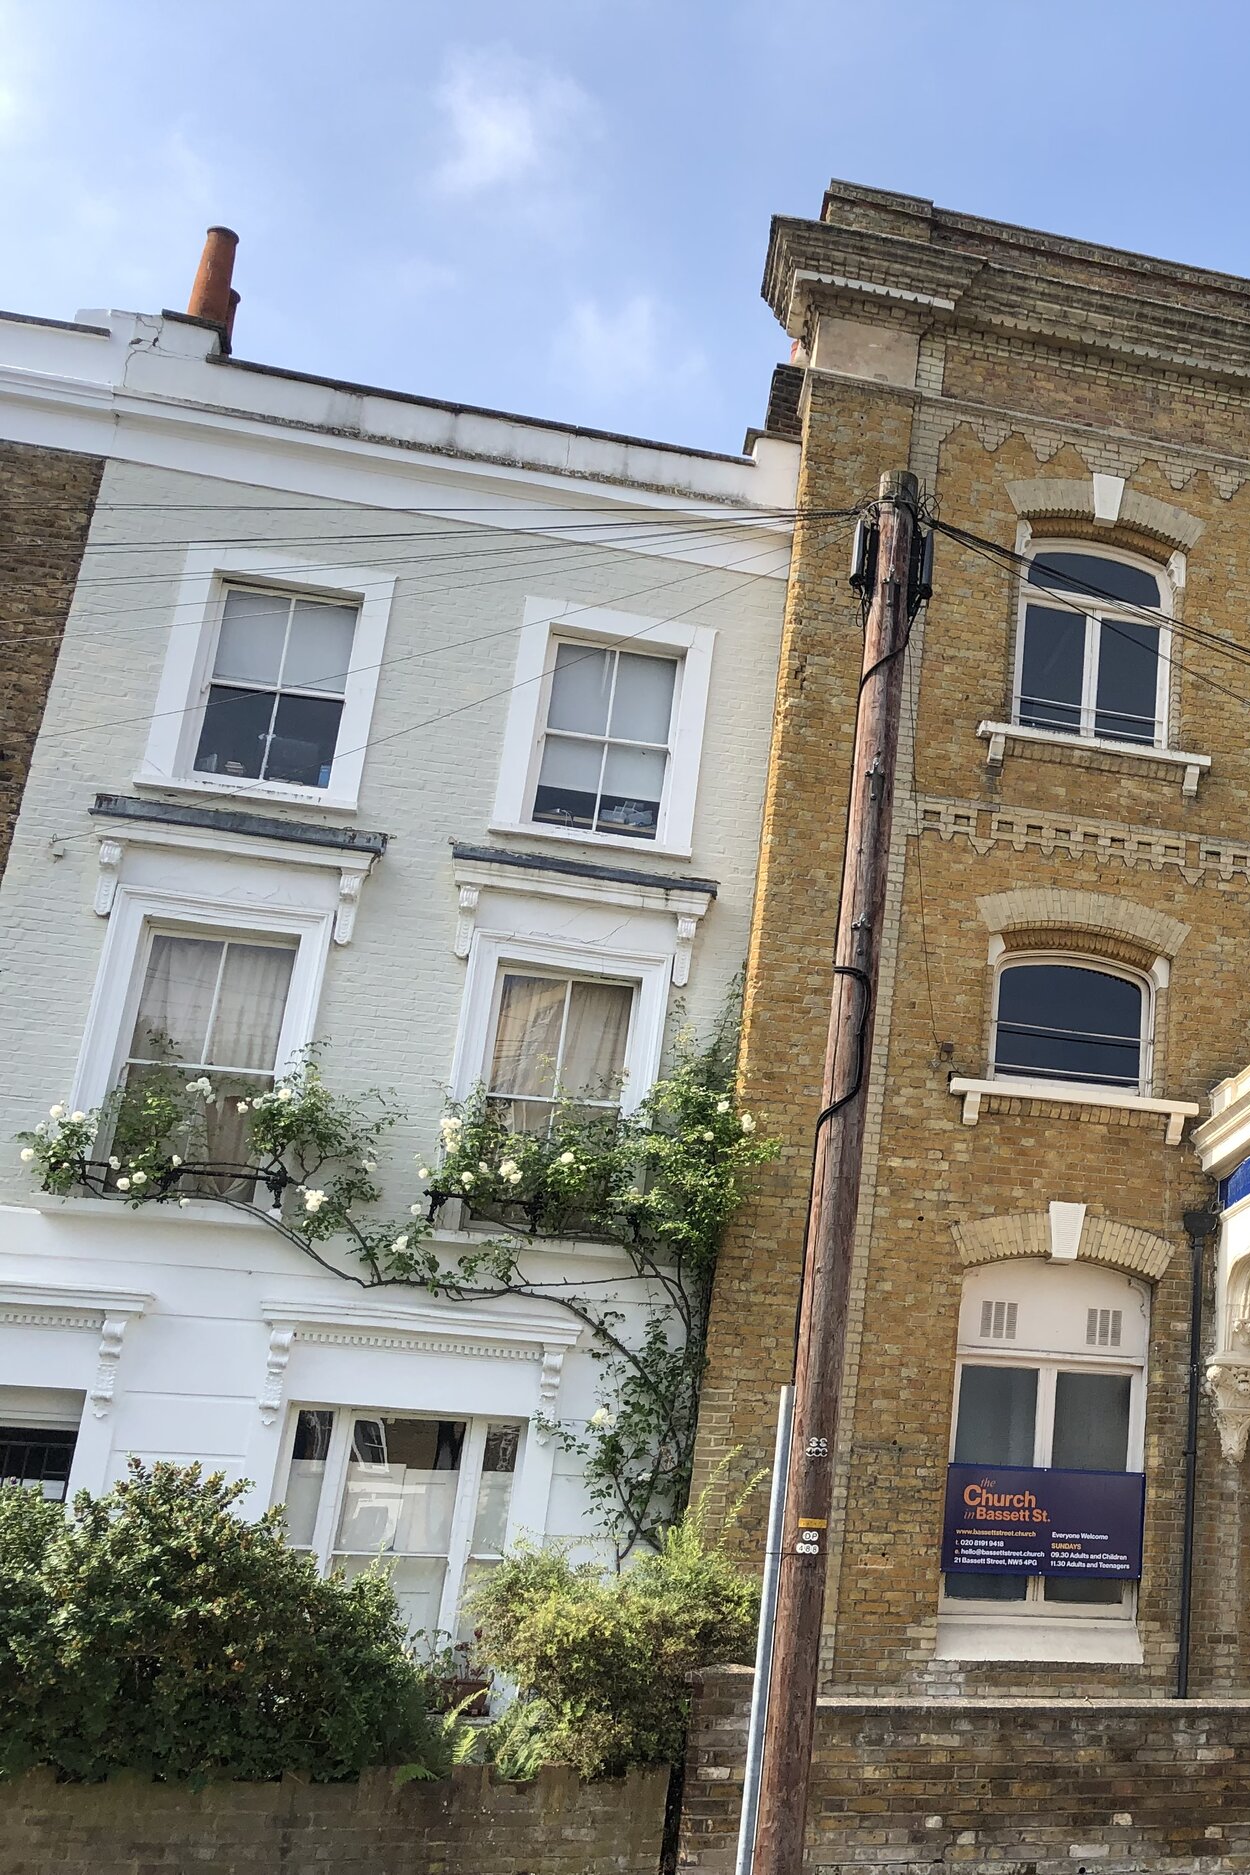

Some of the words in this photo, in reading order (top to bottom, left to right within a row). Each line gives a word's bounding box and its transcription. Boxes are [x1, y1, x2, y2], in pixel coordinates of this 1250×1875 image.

[981, 1477, 997, 1488] the
[963, 1484, 1036, 1508] Church
[963, 1509, 975, 1520] in
[976, 1506, 1030, 1522] Bassett
[1032, 1508, 1051, 1523] St.
[955, 1528, 1037, 1538] www.bassettstreet.church
[1051, 1531, 1080, 1540] Everyone
[1080, 1532, 1109, 1540] Welcome
[1051, 1542, 1082, 1550] SUNDAYS
[1050, 1551, 1069, 1559] 09.30
[1069, 1552, 1089, 1560] Adults
[1102, 1553, 1128, 1561] Children
[1066, 1560, 1086, 1568] Adults
[1098, 1561, 1131, 1570] Teenagers
